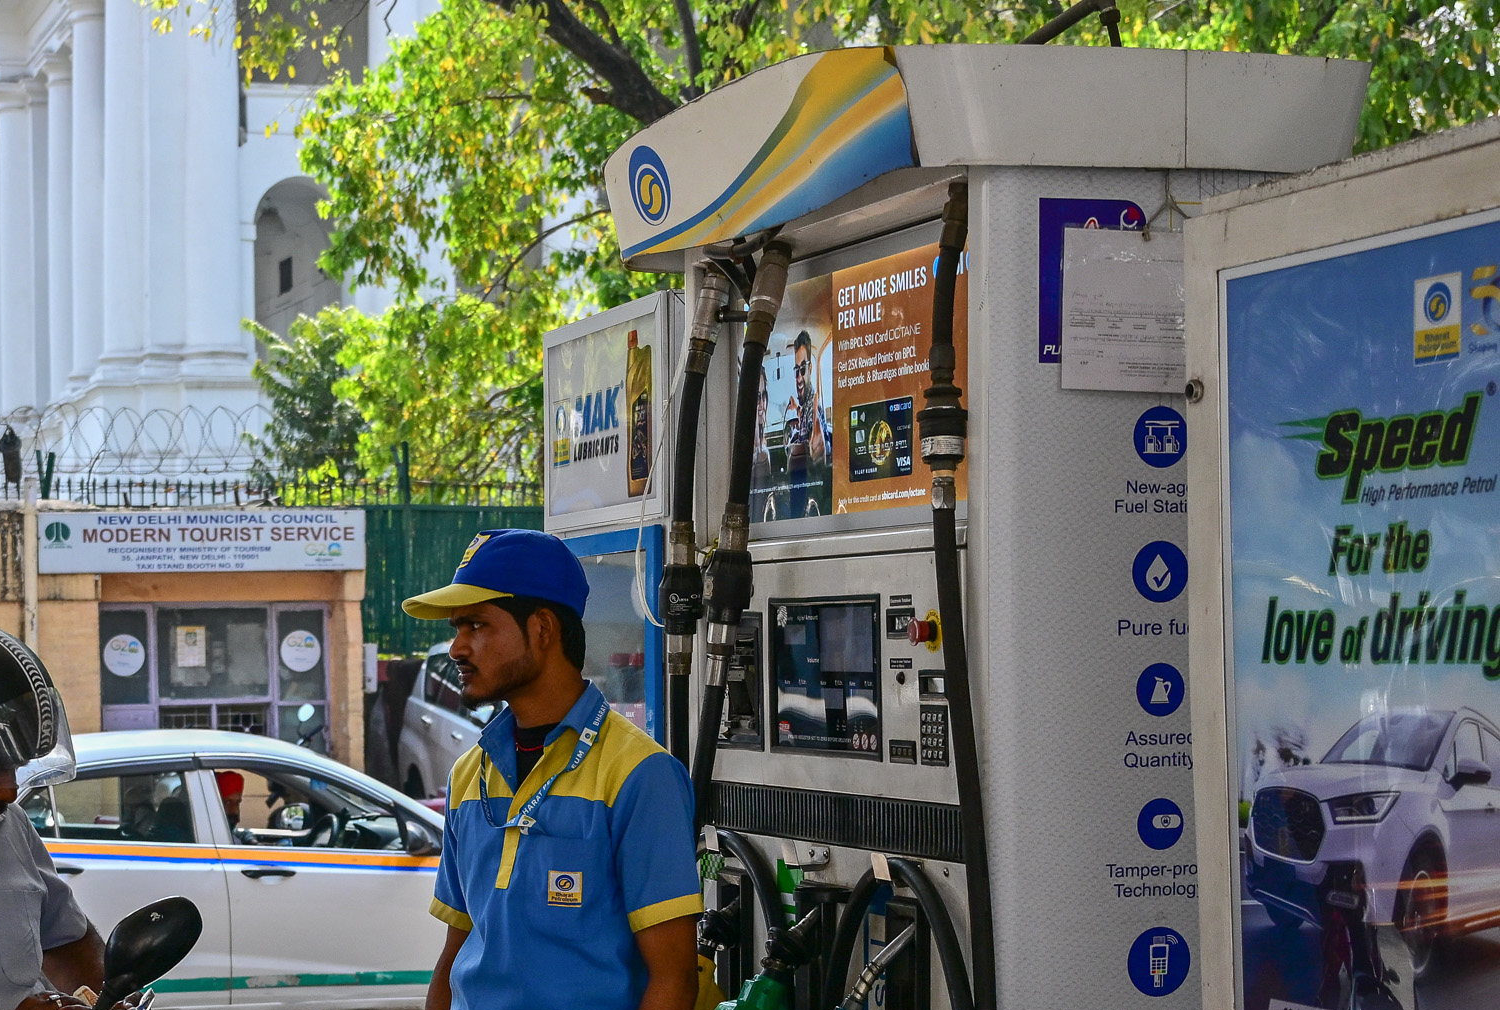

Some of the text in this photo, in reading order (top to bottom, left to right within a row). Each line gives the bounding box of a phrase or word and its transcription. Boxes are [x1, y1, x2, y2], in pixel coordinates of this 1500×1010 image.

[838, 266, 927, 308] GET MORE SMILES
[838, 302, 882, 330] PER MILE
[838, 323, 921, 352] With BPCL SBI Card OCTANE
[838, 360, 848, 373] Get
[859, 353, 877, 368] Reward
[895, 350, 901, 360] on
[903, 346, 916, 359] BPCL
[838, 375, 848, 388] fuel
[848, 373, 865, 389] spends
[867, 371, 872, 382] &
[872, 366, 897, 382] Bharatgas
[898, 361, 914, 376] online
[573, 433, 620, 462] LUBRICANTS
[1315, 391, 1484, 505] Speed
[896, 456, 911, 467] VISA
[882, 487, 926, 501] sbicard.com/octane
[1361, 475, 1498, 506] High Performance Petrol
[1114, 500, 1148, 514] Fuel
[97, 514, 338, 525] NEW DELHI MUNICIPAL COUNCIL
[82, 526, 356, 543] MODERN TOURIST SERVICE
[304, 542, 342, 557] G20
[1328, 520, 1431, 577] For the
[1117, 619, 1163, 637] Pure
[1261, 590, 1500, 680] love of driving
[110, 639, 139, 653] G20
[287, 635, 315, 648] G20
[1113, 882, 1199, 898] Technolog
